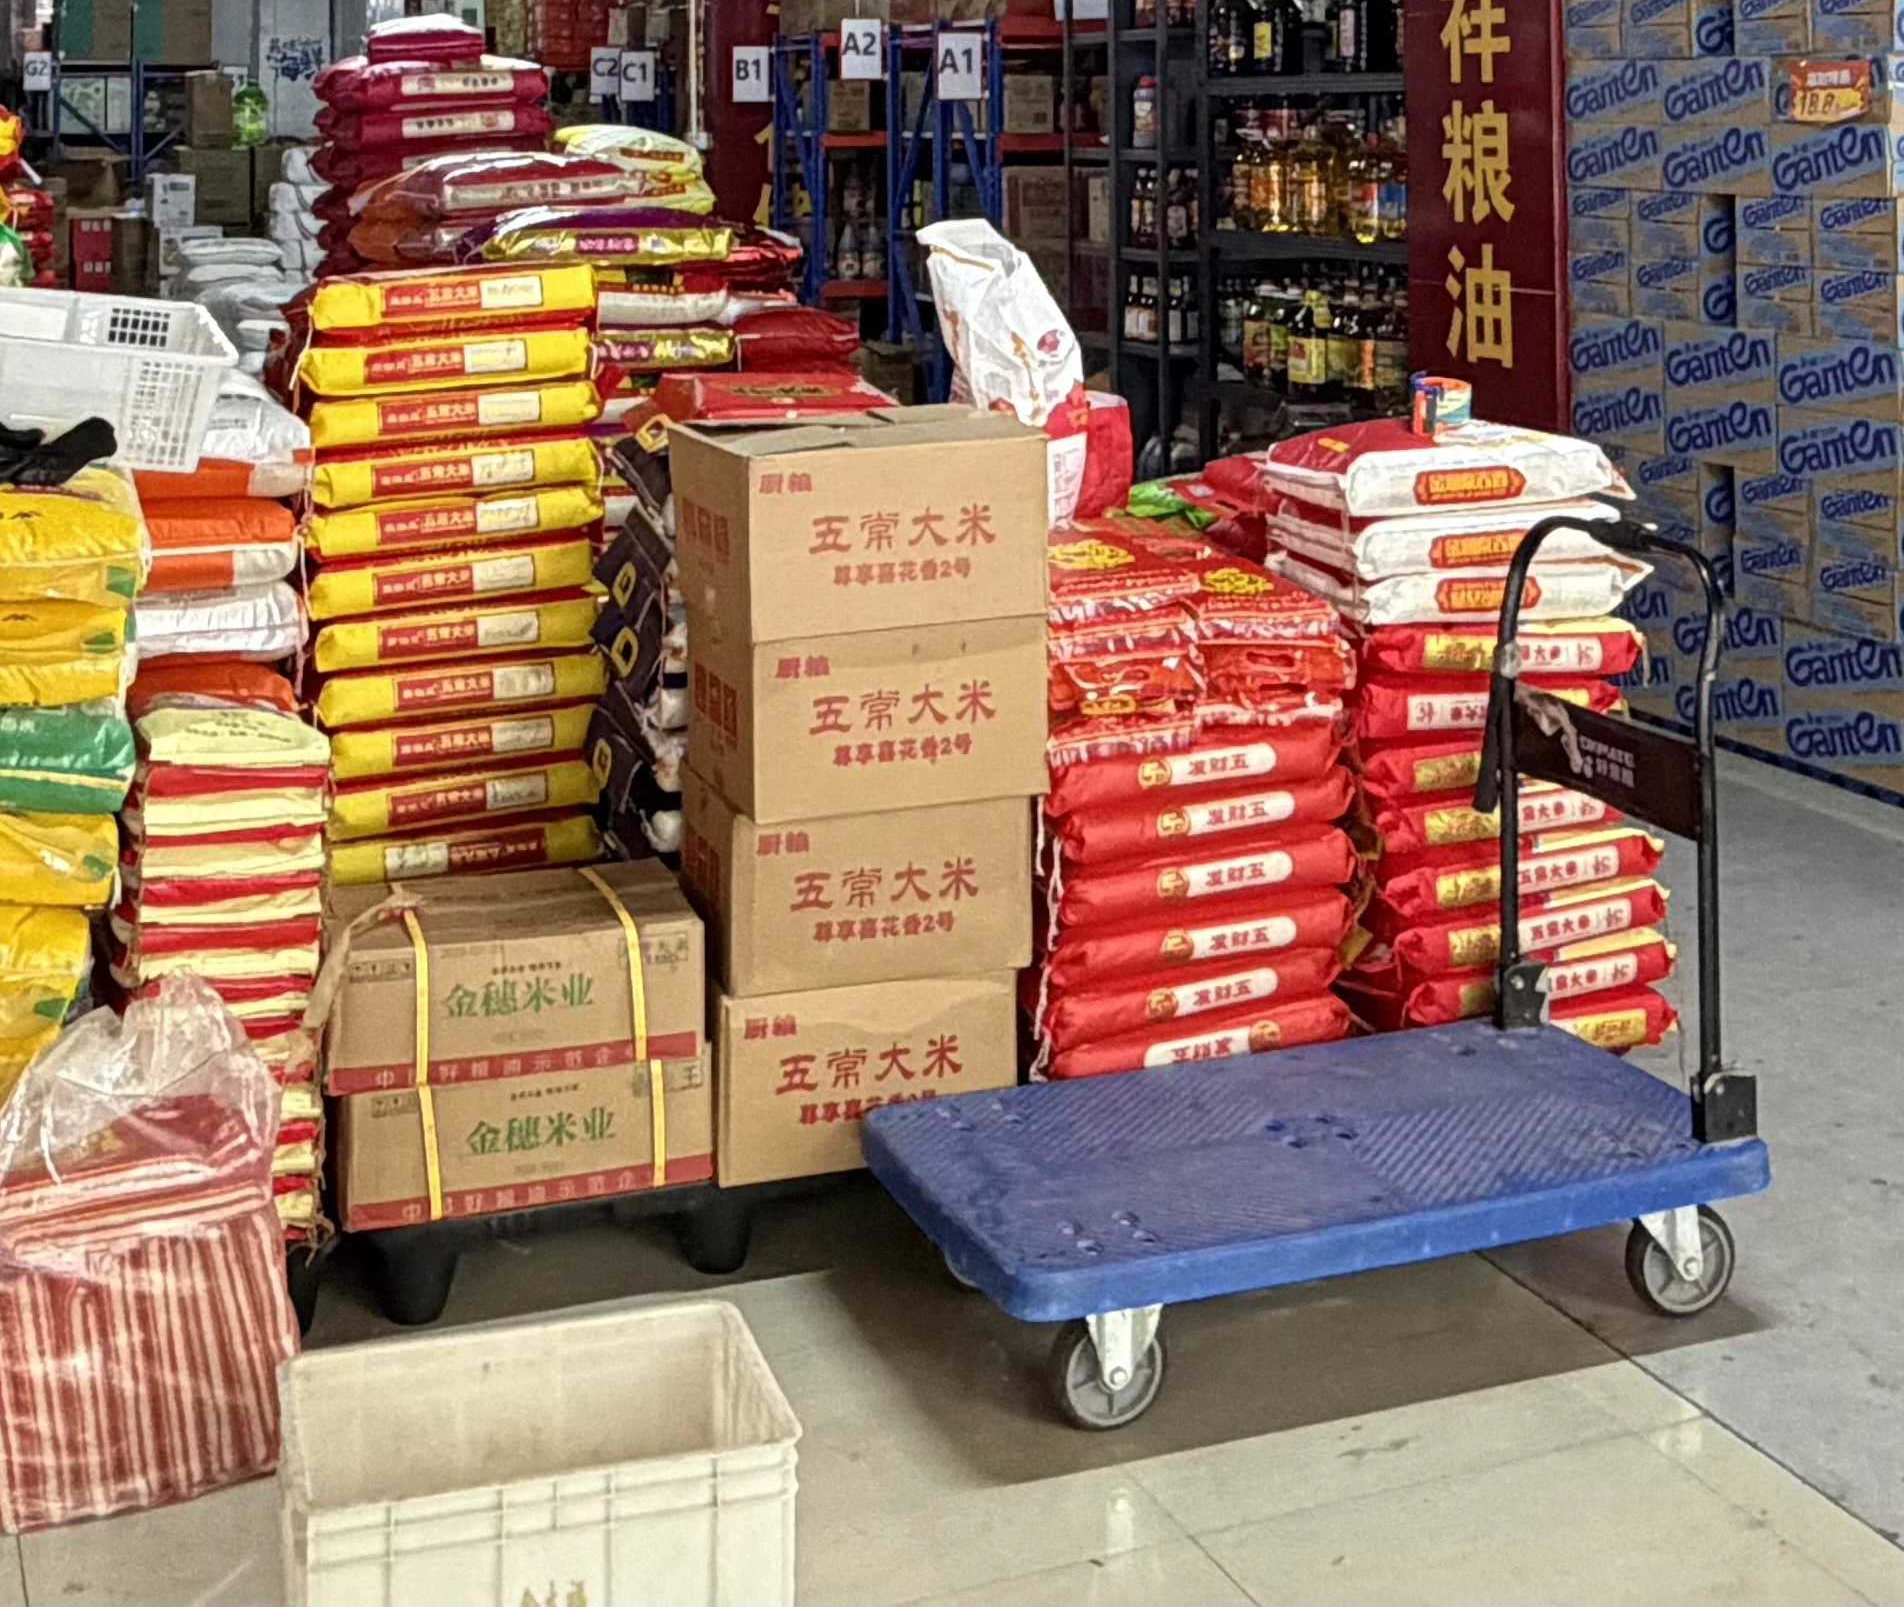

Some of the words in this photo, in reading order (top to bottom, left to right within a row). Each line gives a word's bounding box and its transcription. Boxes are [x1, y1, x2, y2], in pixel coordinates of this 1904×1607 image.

[592, 58, 617, 77] C2
[736, 59, 761, 81] B1
[842, 32, 876, 56] A2
[939, 48, 974, 75] A1
[623, 63, 647, 82] C1
[1566, 62, 1658, 119] Ganten
[1664, 58, 1764, 121] Ganten
[1567, 127, 1657, 182] Ganten
[1662, 127, 1765, 188] Ganten
[1773, 126, 1886, 191] Ganten
[1571, 319, 1659, 372] Ganten
[1666, 331, 1771, 387] Ganten
[1779, 345, 1895, 404] Ganten
[1573, 385, 1661, 435] Ganten
[1667, 401, 1772, 455] Ganten
[1780, 419, 1895, 475] Ganten
[809, 503, 997, 555] 五常大米
[1786, 640, 1901, 686] Ganten
[809, 680, 997, 736] 五常大米
[1787, 712, 1901, 759] Ganten
[789, 857, 979, 912] 五常大米
[776, 1034, 963, 1096] 五常大米
